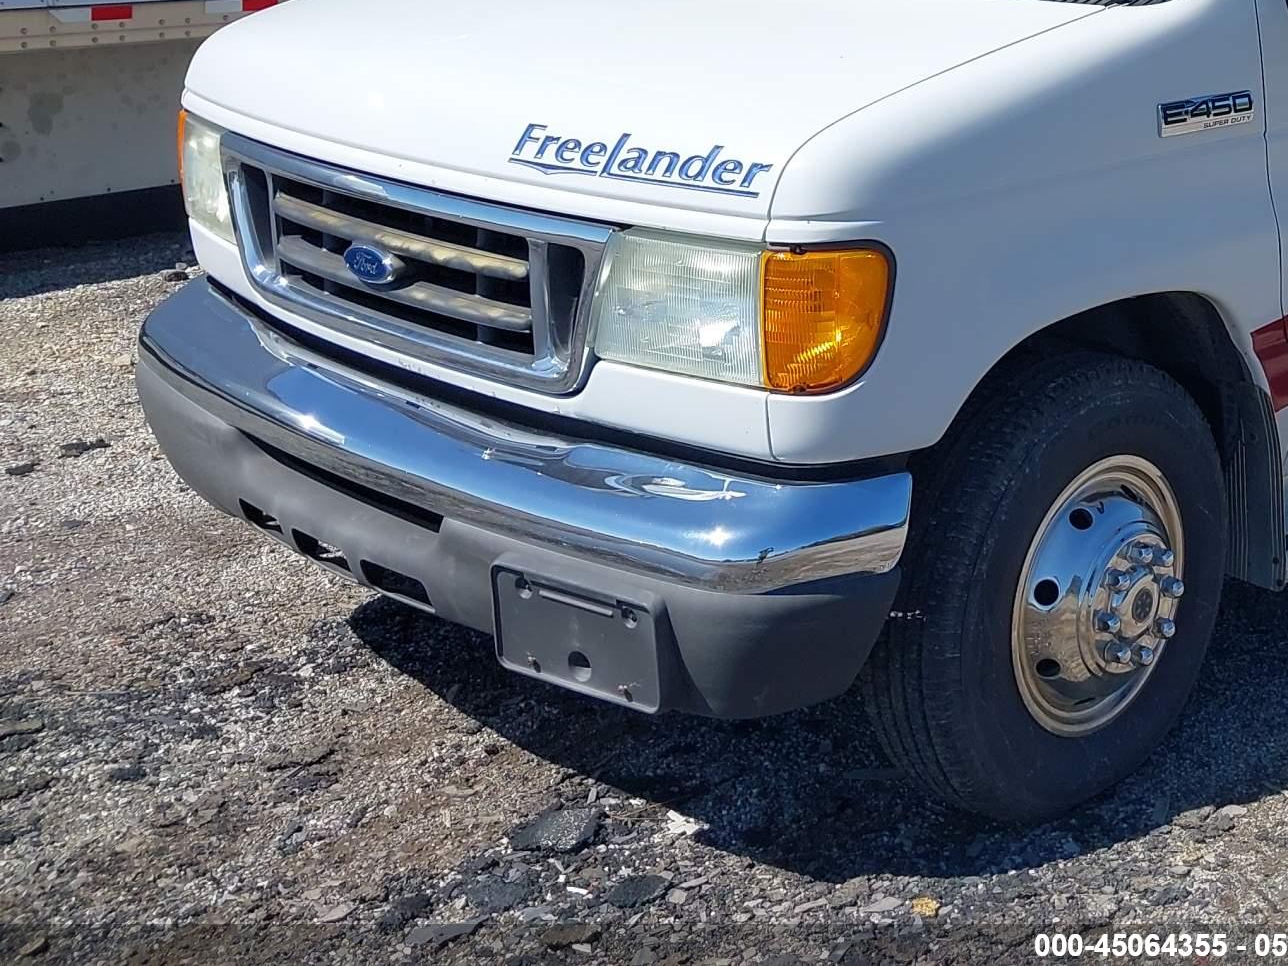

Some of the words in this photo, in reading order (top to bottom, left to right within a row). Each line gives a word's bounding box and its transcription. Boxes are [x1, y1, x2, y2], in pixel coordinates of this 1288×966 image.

[1203, 119, 1229, 128] SUPER
[1231, 114, 1252, 124] DUTY
[508, 122, 773, 198] Freelander
[353, 251, 379, 275] Ford
